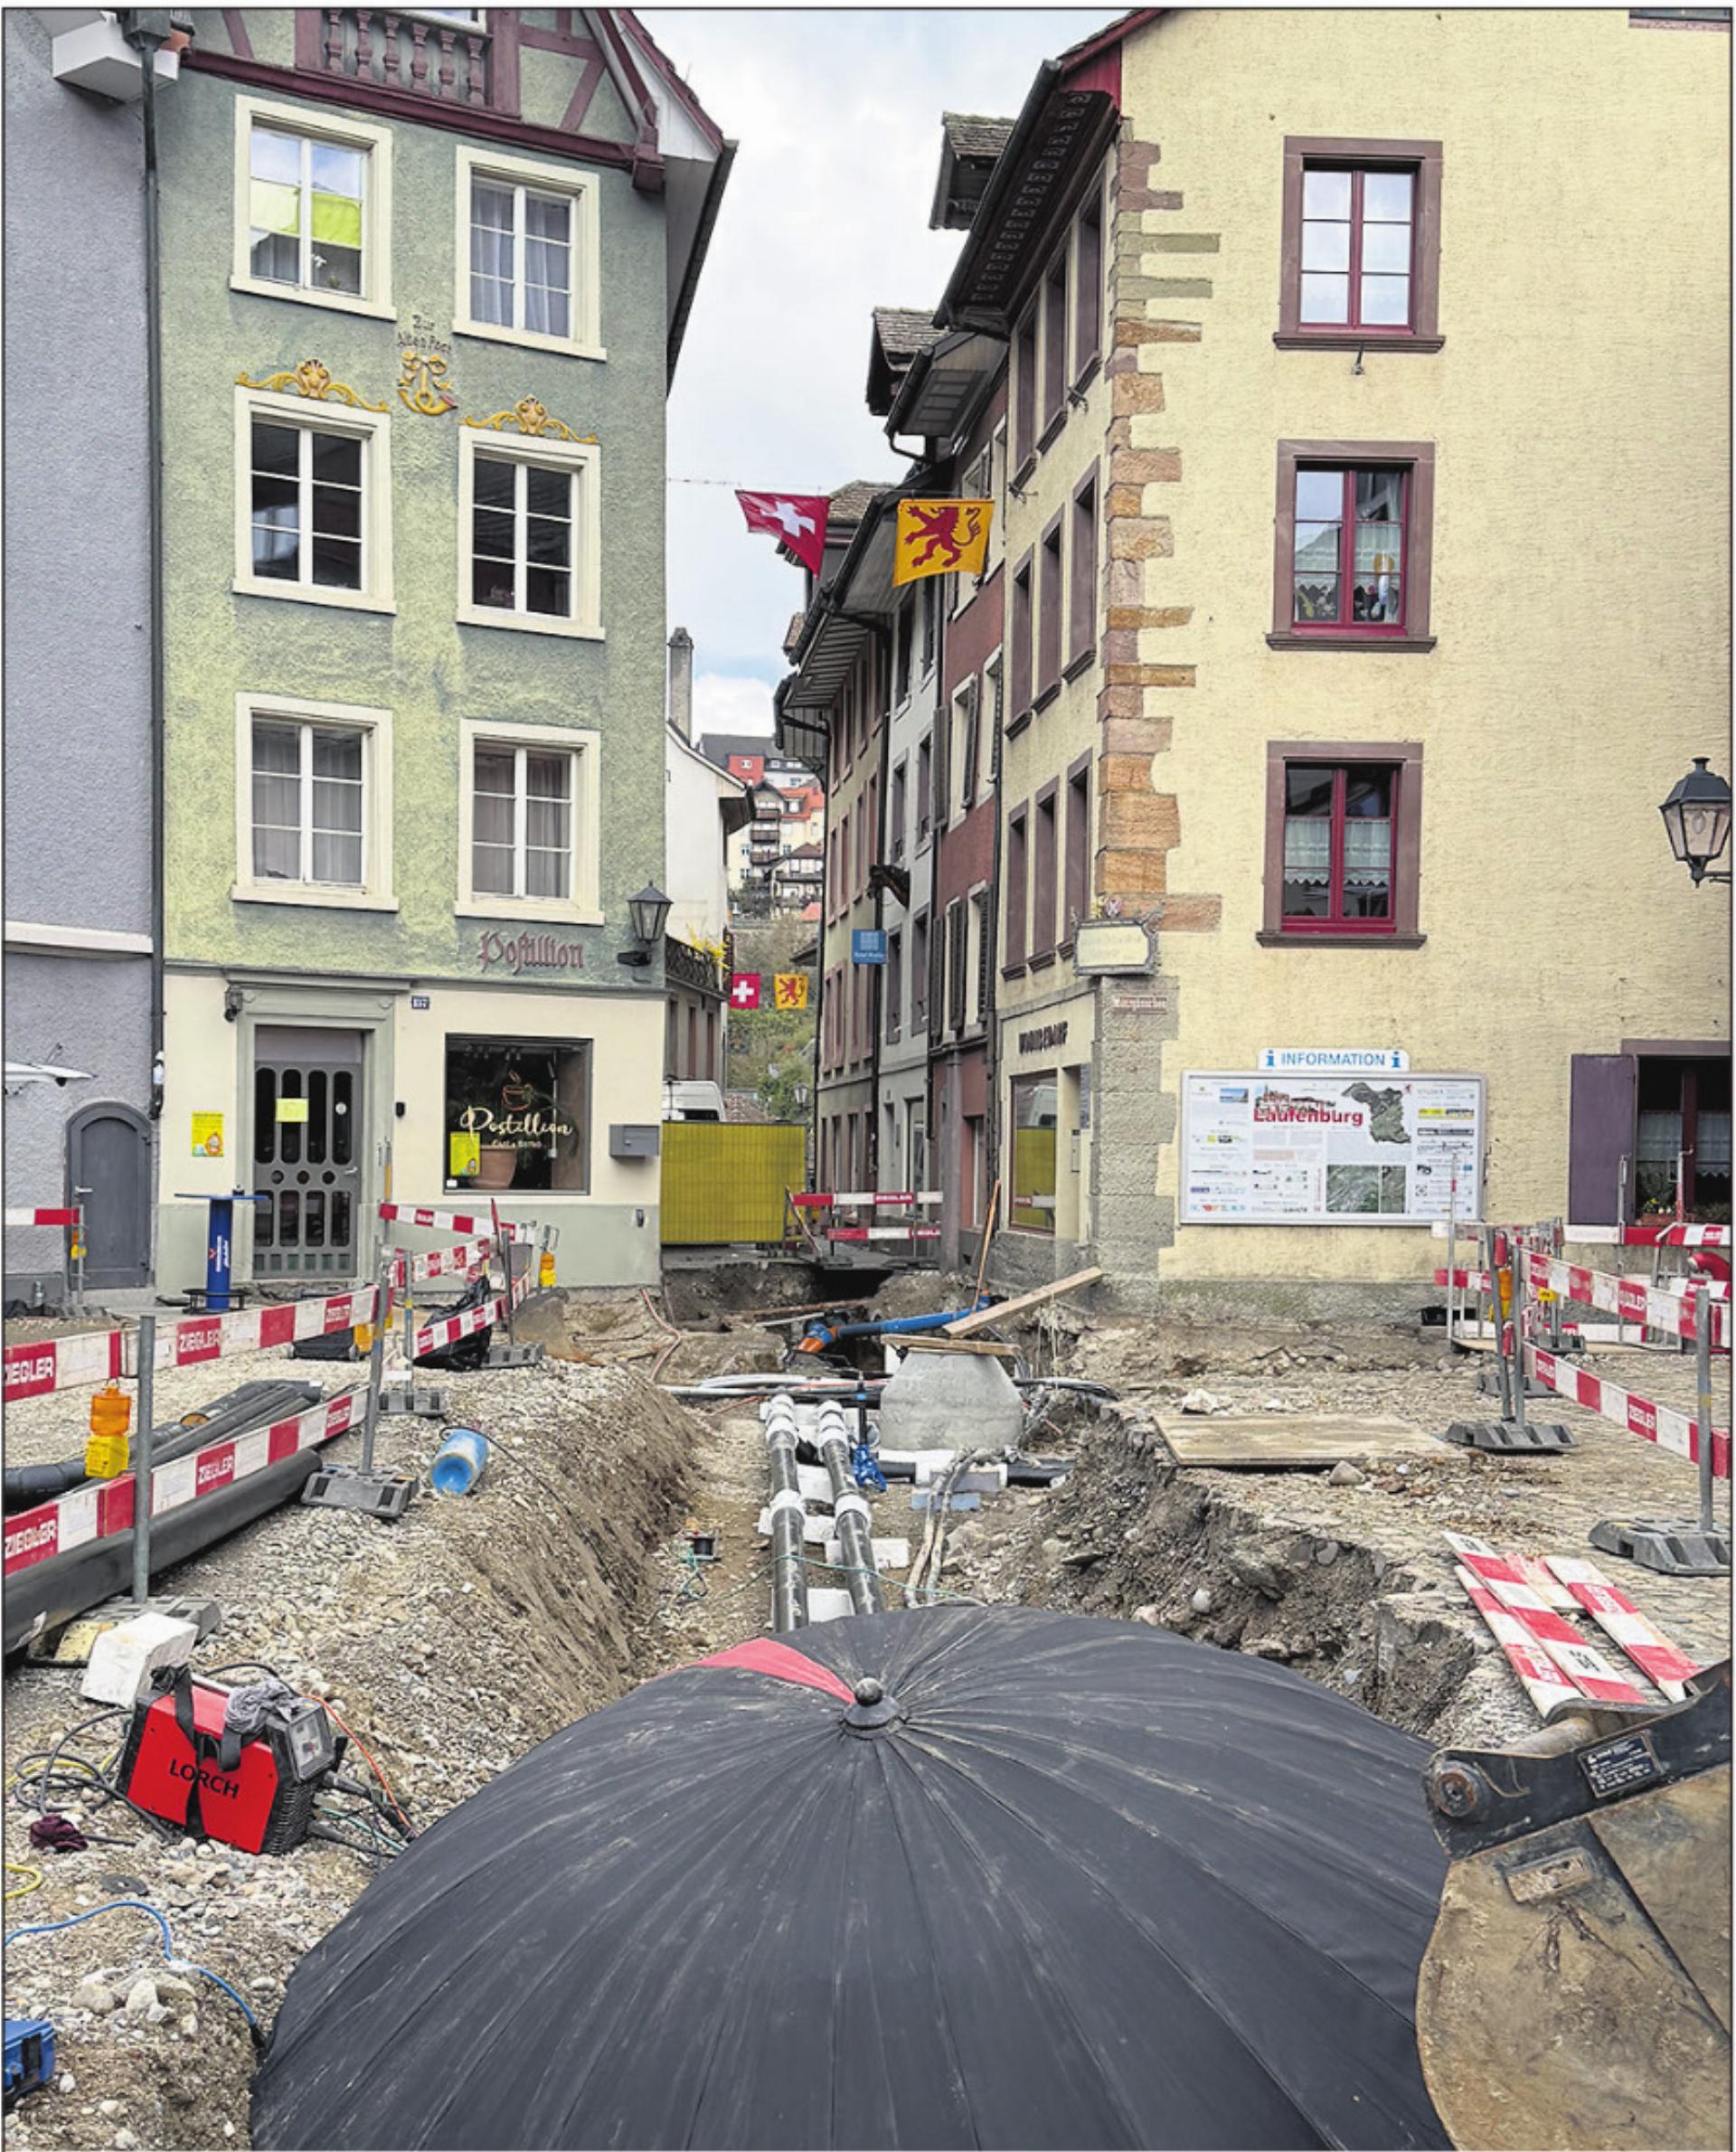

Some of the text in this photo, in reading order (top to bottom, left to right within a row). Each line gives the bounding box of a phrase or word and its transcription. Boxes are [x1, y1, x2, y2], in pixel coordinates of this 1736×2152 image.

[1280, 1052, 1386, 1066] INFORMATION
[1253, 1107, 1363, 1127] Laufenburg
[169, 1759, 240, 1799] LORCH
